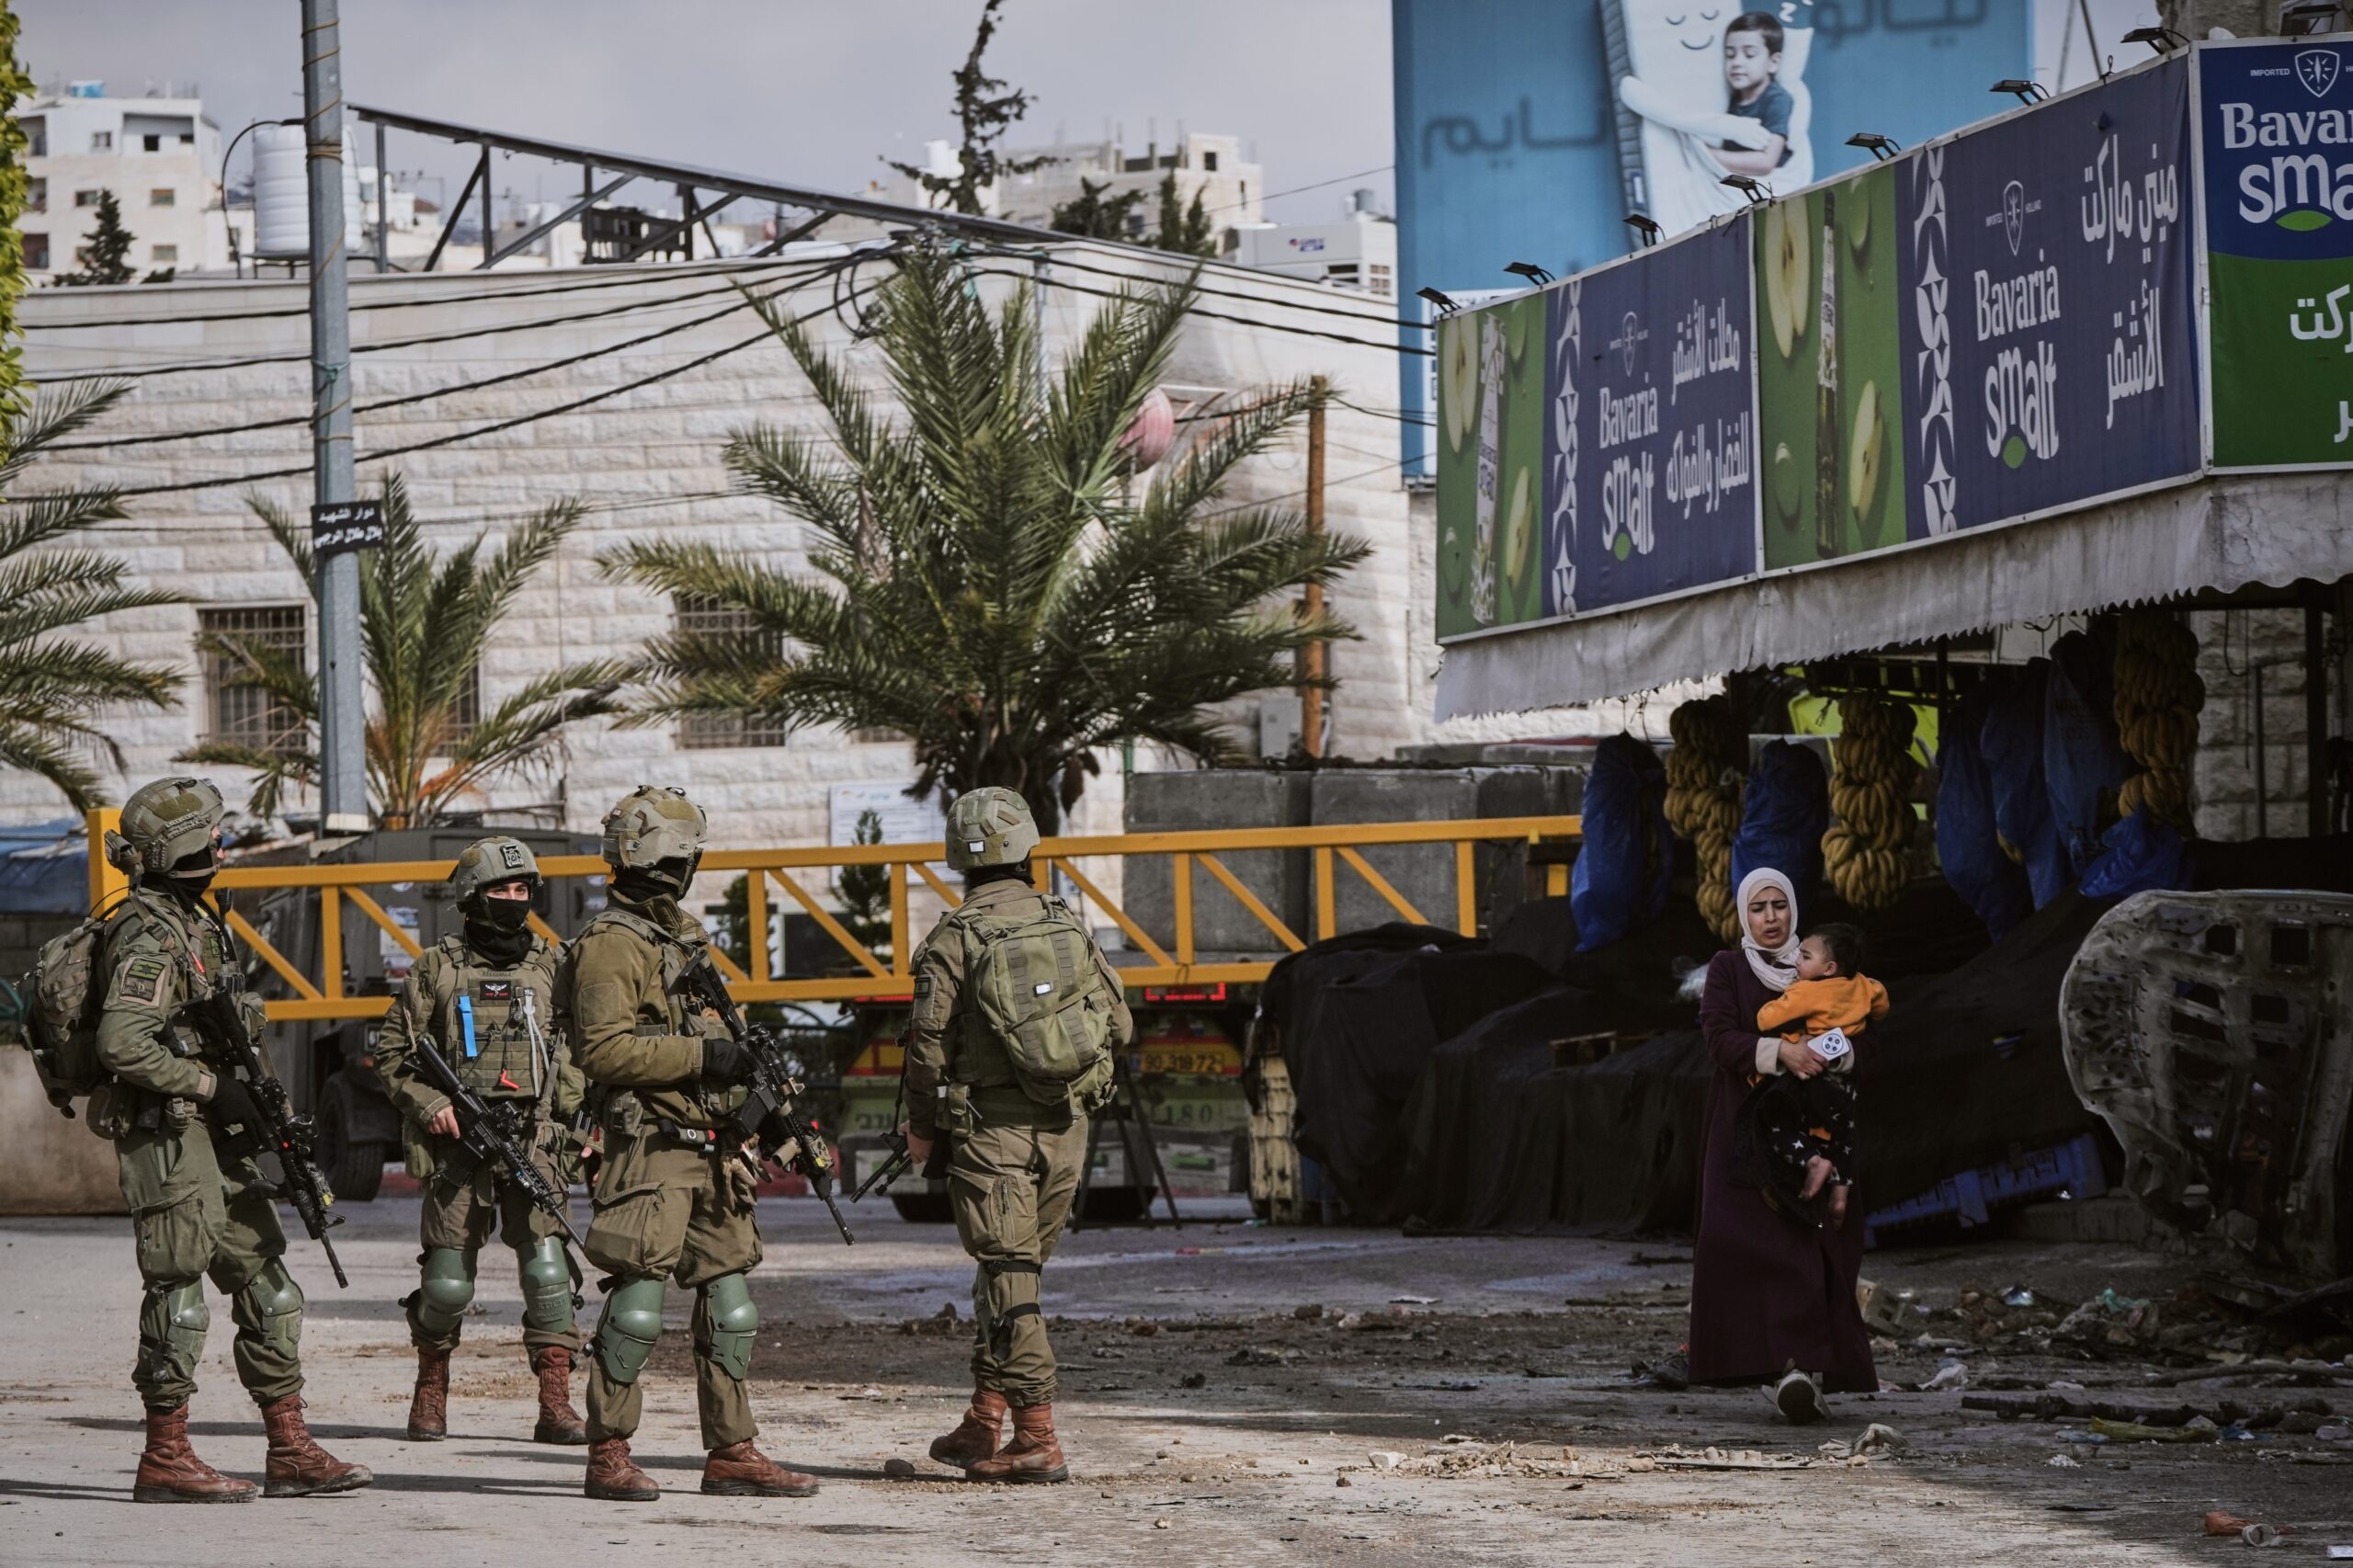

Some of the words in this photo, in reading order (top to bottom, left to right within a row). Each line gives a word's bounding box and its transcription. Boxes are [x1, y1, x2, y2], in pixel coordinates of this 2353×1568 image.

[2250, 68, 2290, 76] IMPORTED
[2220, 102, 2353, 149] Bava
[2081, 133, 2132, 265] ماركت
[2139, 143, 2178, 264] ميني
[1709, 298, 1740, 373] محلات
[1974, 249, 2060, 341] Bavaria
[1671, 299, 1705, 406] الأشقر
[1984, 340, 2059, 460] smalt
[2106, 278, 2164, 430] الأشقر
[1599, 371, 1658, 449] Bavaria
[1602, 451, 1654, 555] smalt
[1666, 423, 1712, 520] والفواكه
[1714, 411, 1749, 511] للخضار
